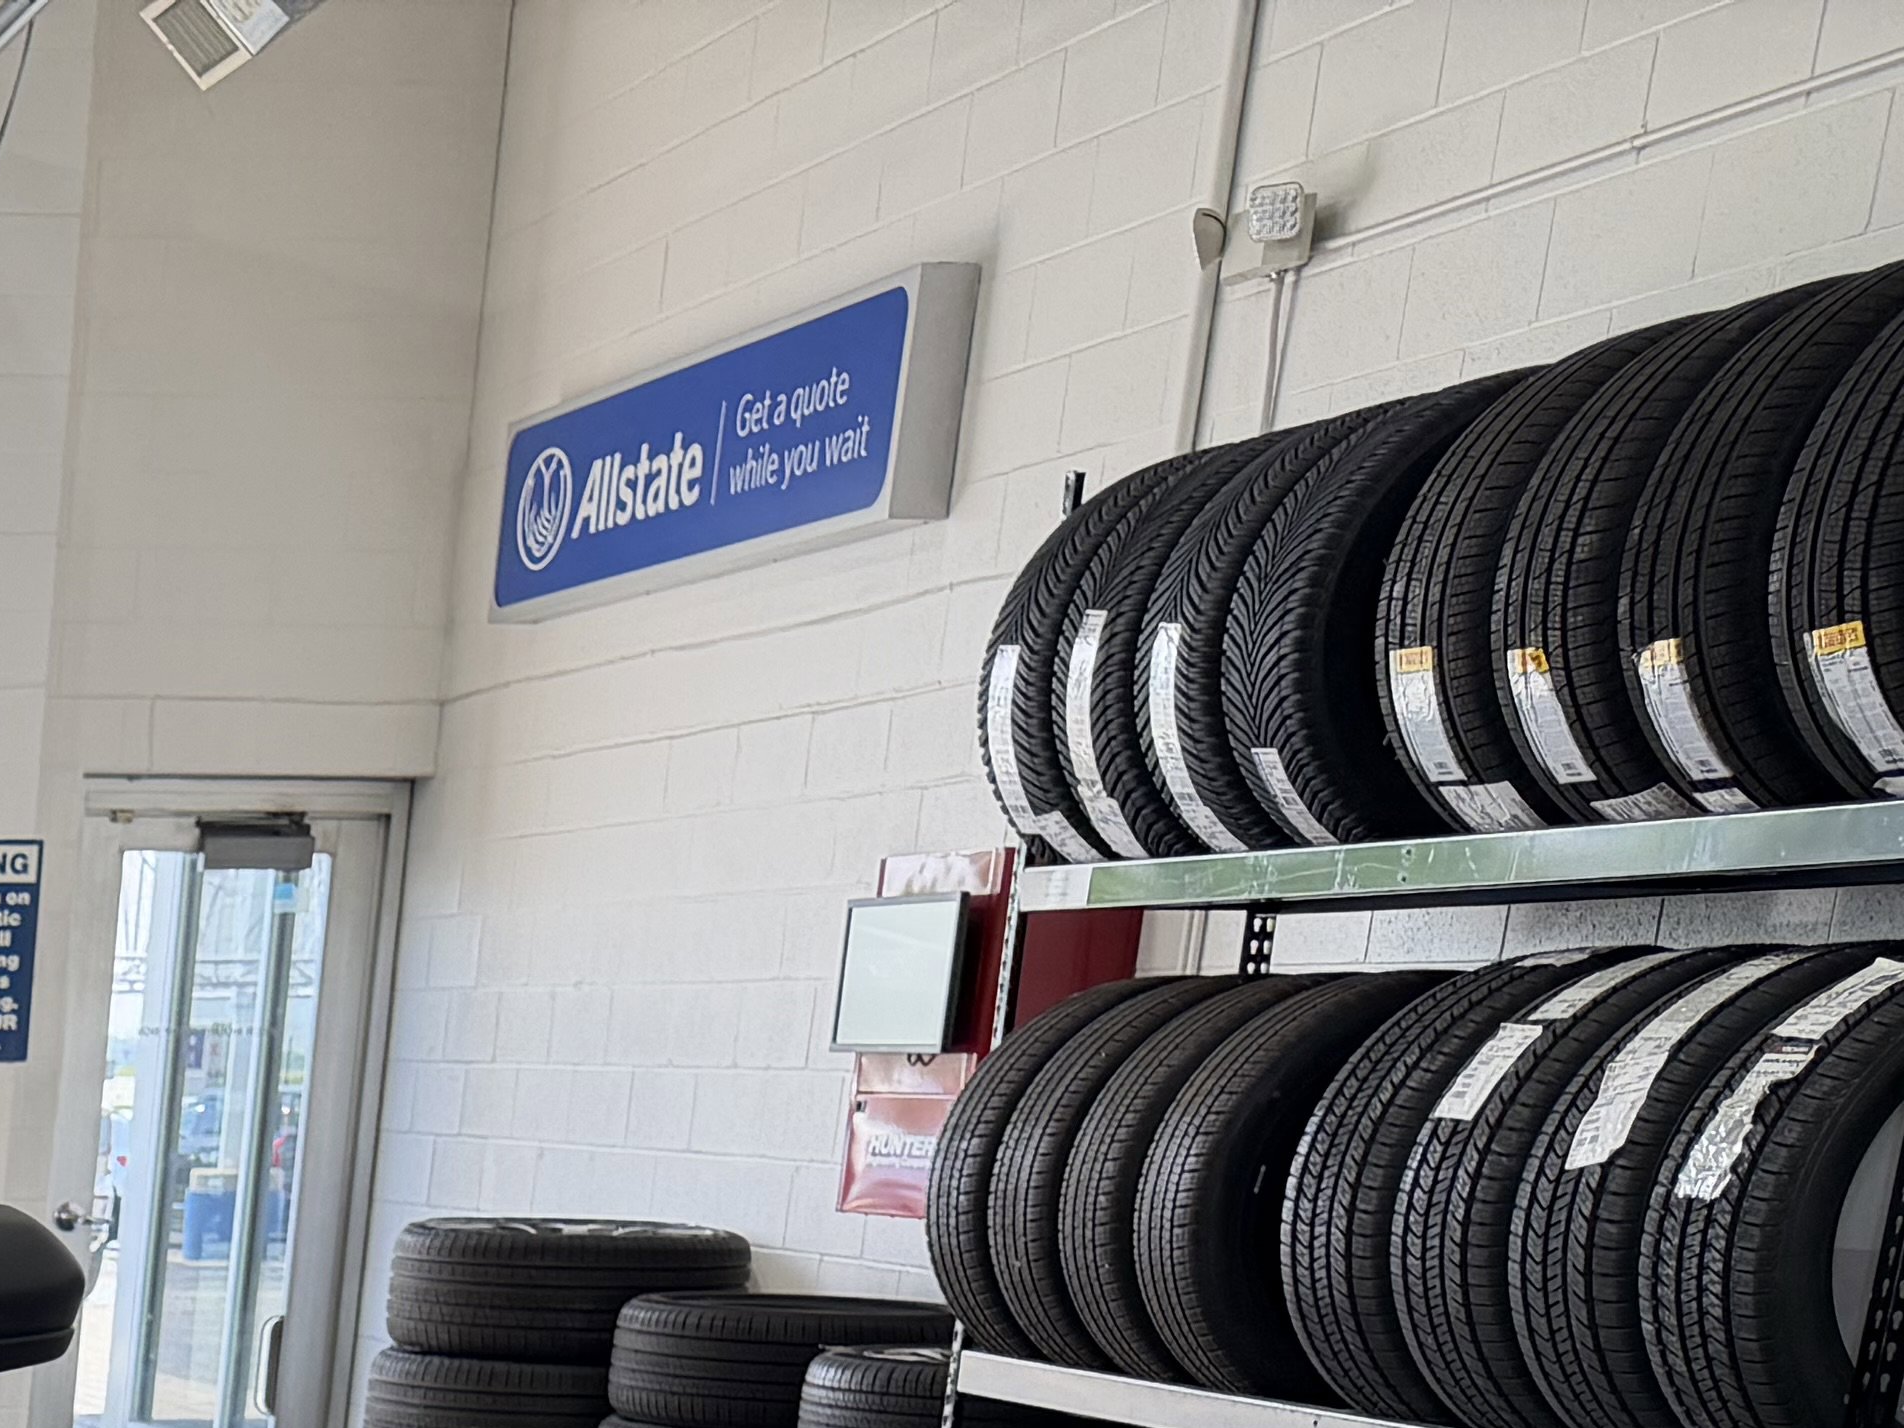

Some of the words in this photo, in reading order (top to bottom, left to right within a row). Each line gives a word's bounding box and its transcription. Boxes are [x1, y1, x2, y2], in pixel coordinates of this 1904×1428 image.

[735, 392, 771, 437] Get
[773, 393, 787, 427] a
[789, 367, 850, 428] quote
[571, 431, 703, 539] Allstate
[729, 443, 779, 495] while
[780, 443, 819, 491] you
[824, 414, 871, 466] wait
[5, 892, 31, 906] on
[868, 1134, 936, 1158] HUNTER
